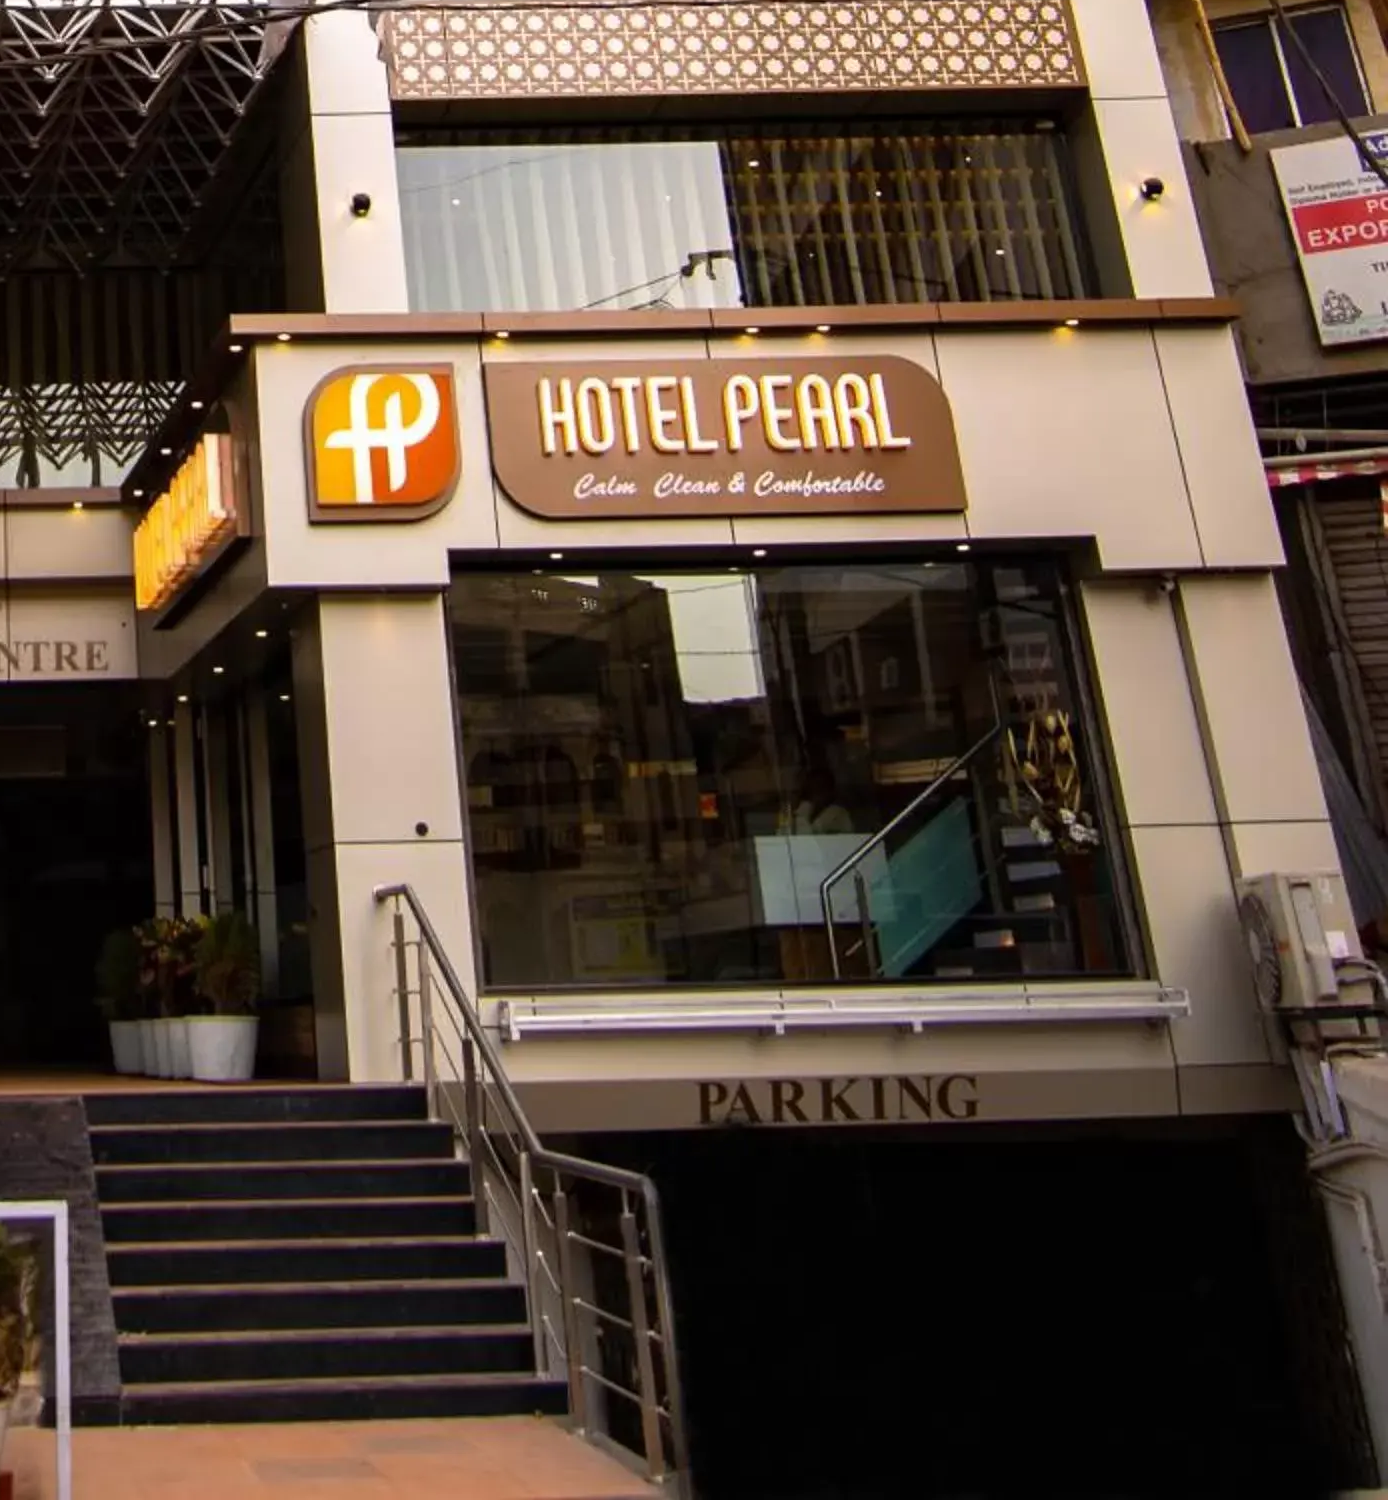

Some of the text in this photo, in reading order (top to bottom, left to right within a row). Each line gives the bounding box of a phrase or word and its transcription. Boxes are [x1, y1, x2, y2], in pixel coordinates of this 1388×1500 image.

[538, 373, 911, 457] HOTEL PEARL
[573, 469, 886, 500] Calm Clean & Comfortable
[697, 1074, 981, 1125] PARKING
